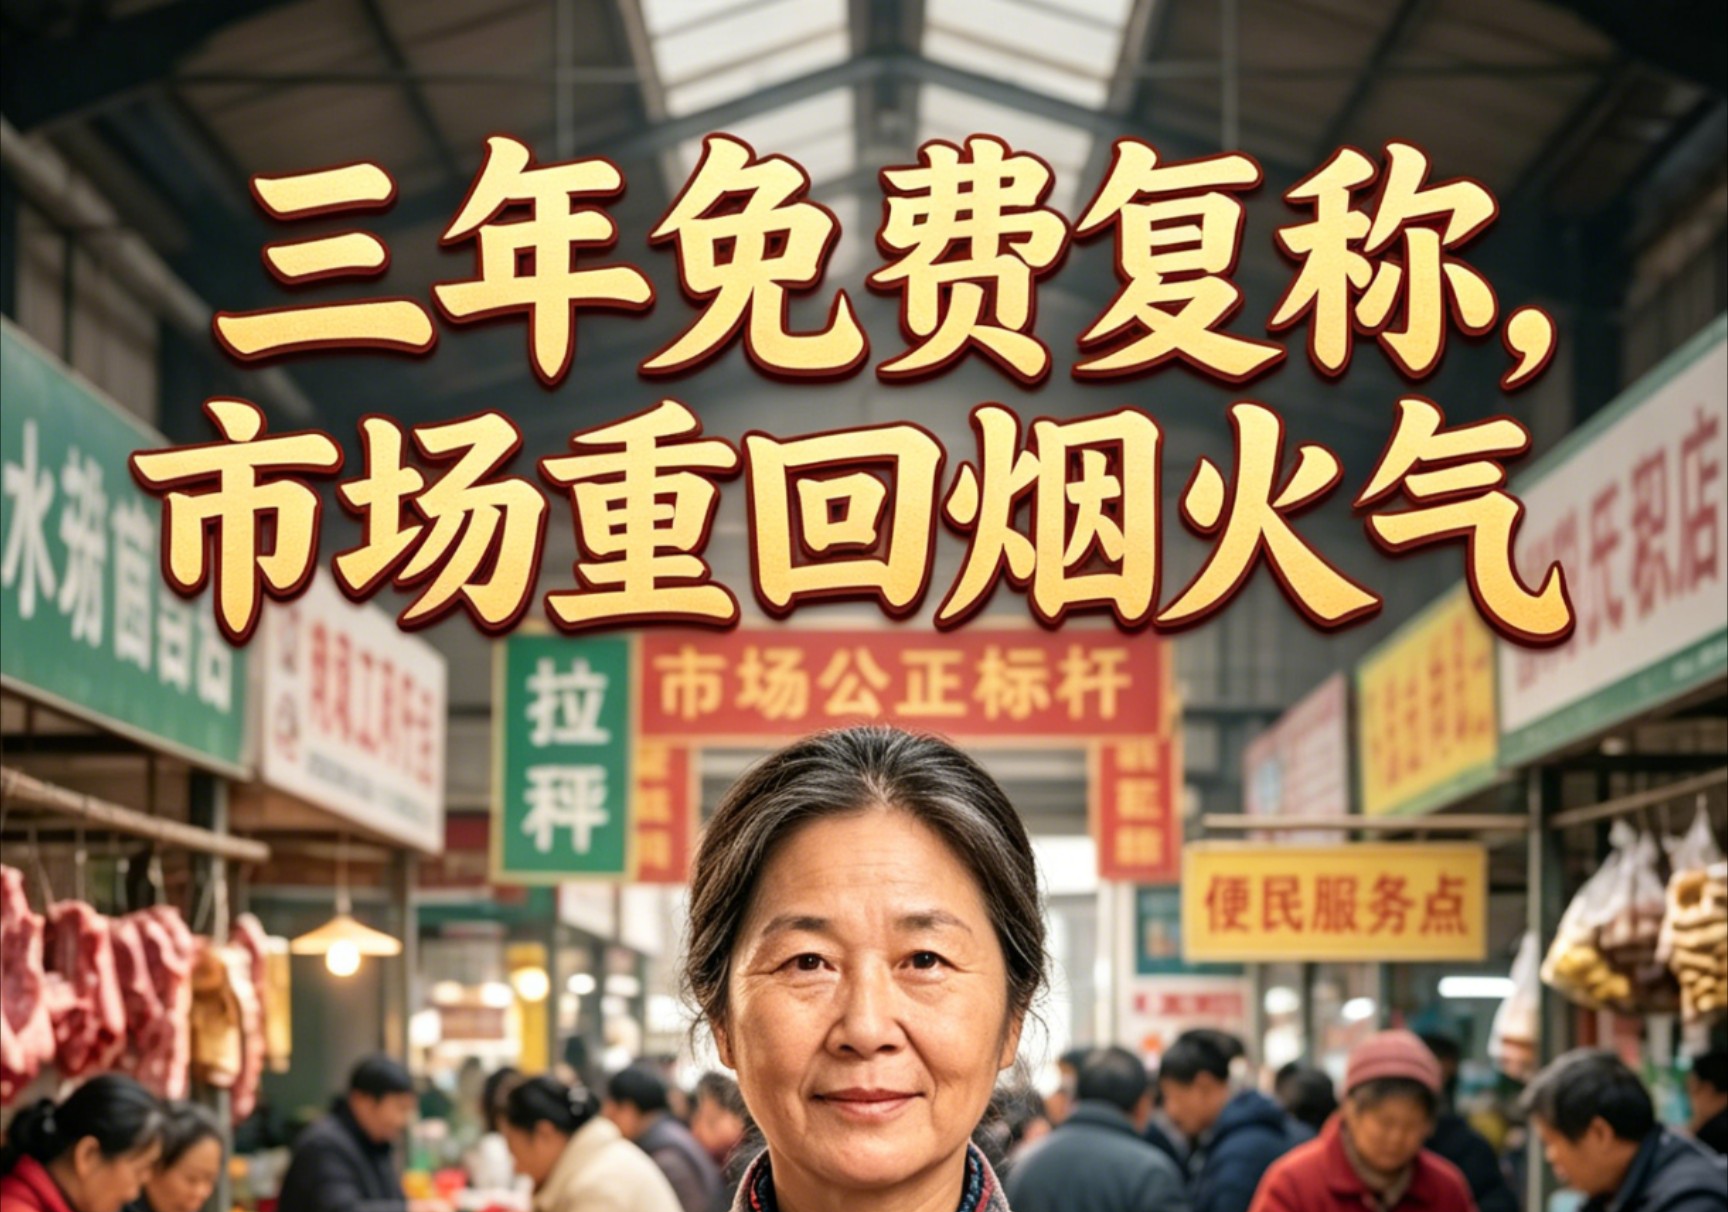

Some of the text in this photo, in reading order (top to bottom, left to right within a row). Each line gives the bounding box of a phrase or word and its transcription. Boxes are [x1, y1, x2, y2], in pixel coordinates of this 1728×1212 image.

[653, 647, 1133, 719] 市场公正标杆
[1205, 872, 1468, 934] 便民服务点
